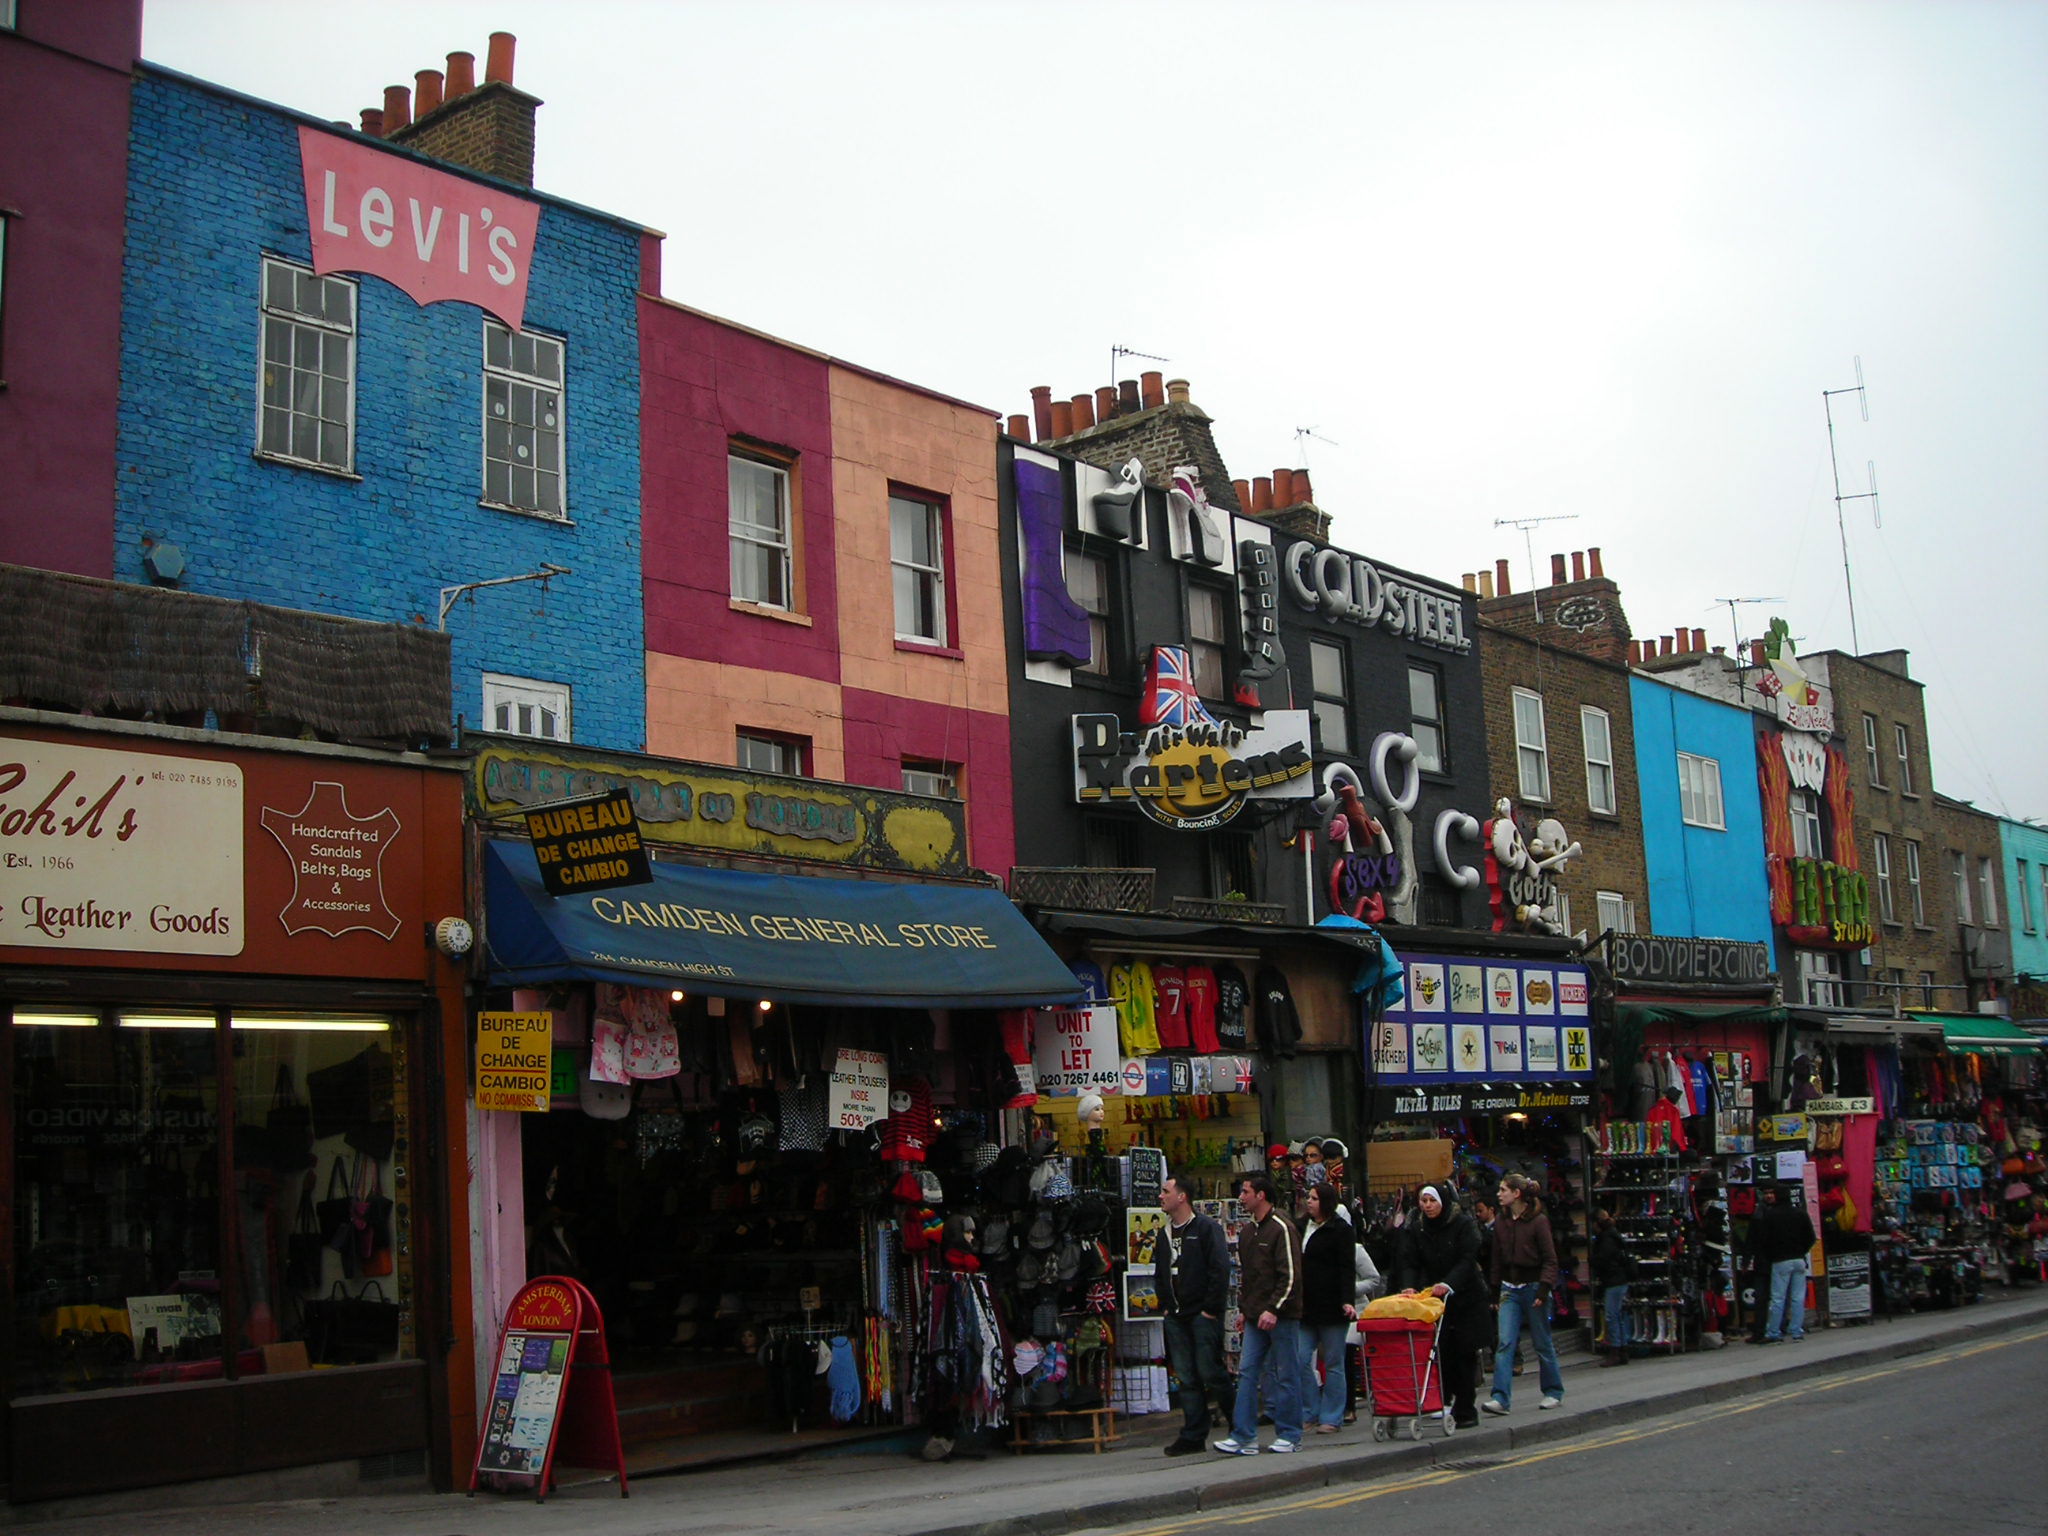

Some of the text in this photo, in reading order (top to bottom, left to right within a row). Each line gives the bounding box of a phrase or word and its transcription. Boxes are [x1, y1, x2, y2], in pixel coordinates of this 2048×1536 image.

[1079, 740, 1313, 799] Martens
[169, 772, 186, 783] 020
[1222, 800, 1241, 820] SOLES
[528, 799, 632, 839] BUREAU
[1155, 811, 1173, 825] WITH
[1177, 815, 1220, 829] Bouncing
[291, 823, 379, 842] Handcrafted
[310, 843, 362, 859] Sandals
[536, 832, 640, 864] DE CHANGE
[3, 853, 74, 870] Est. 1966
[560, 859, 630, 885] CAMBIO
[331, 882, 342, 895] &
[302, 898, 371, 912] Accessories
[21, 895, 133, 939] Leather
[149, 904, 231, 935] Goods
[591, 896, 997, 950] CAMDEN GENERAL STORE
[1833, 919, 1873, 945] STUDIO
[619, 956, 682, 972] CAMDEN
[681, 963, 718, 975] HIGH
[717, 965, 736, 977] ST
[1167, 988, 1181, 1016] 7
[481, 1018, 547, 1032] BUREAU
[1056, 1011, 1093, 1034] UNIT
[501, 1036, 521, 1050] DE
[1068, 1035, 1083, 1048] TO
[481, 1053, 547, 1068] CHANGE
[1062, 1050, 1092, 1071] LET
[480, 1075, 546, 1091] CAMBIO
[858, 1075, 887, 1089] TROUSERS
[1040, 1073, 1061, 1087] 020
[1064, 1072, 1090, 1085] 7267
[1092, 1071, 1119, 1083] 4461
[480, 1092, 492, 1105] NO
[850, 1089, 869, 1102] INSIDE
[1471, 1098, 1484, 1110] THE
[1486, 1098, 1517, 1110] ORIGINAL
[1570, 1095, 1590, 1106] STORE
[842, 1103, 876, 1113] MORE THAN
[1395, 1094, 1463, 1114] METAL RULES
[1851, 1099, 1868, 1110] £3
[840, 1113, 874, 1128] 50% OFF
[1135, 1152, 1158, 1163] BITCH
[1132, 1161, 1161, 1172] PARKING
[1136, 1170, 1156, 1181] ONLY
[517, 1286, 572, 1316] AMSTERDAM
[522, 1314, 562, 1326] LONDON
